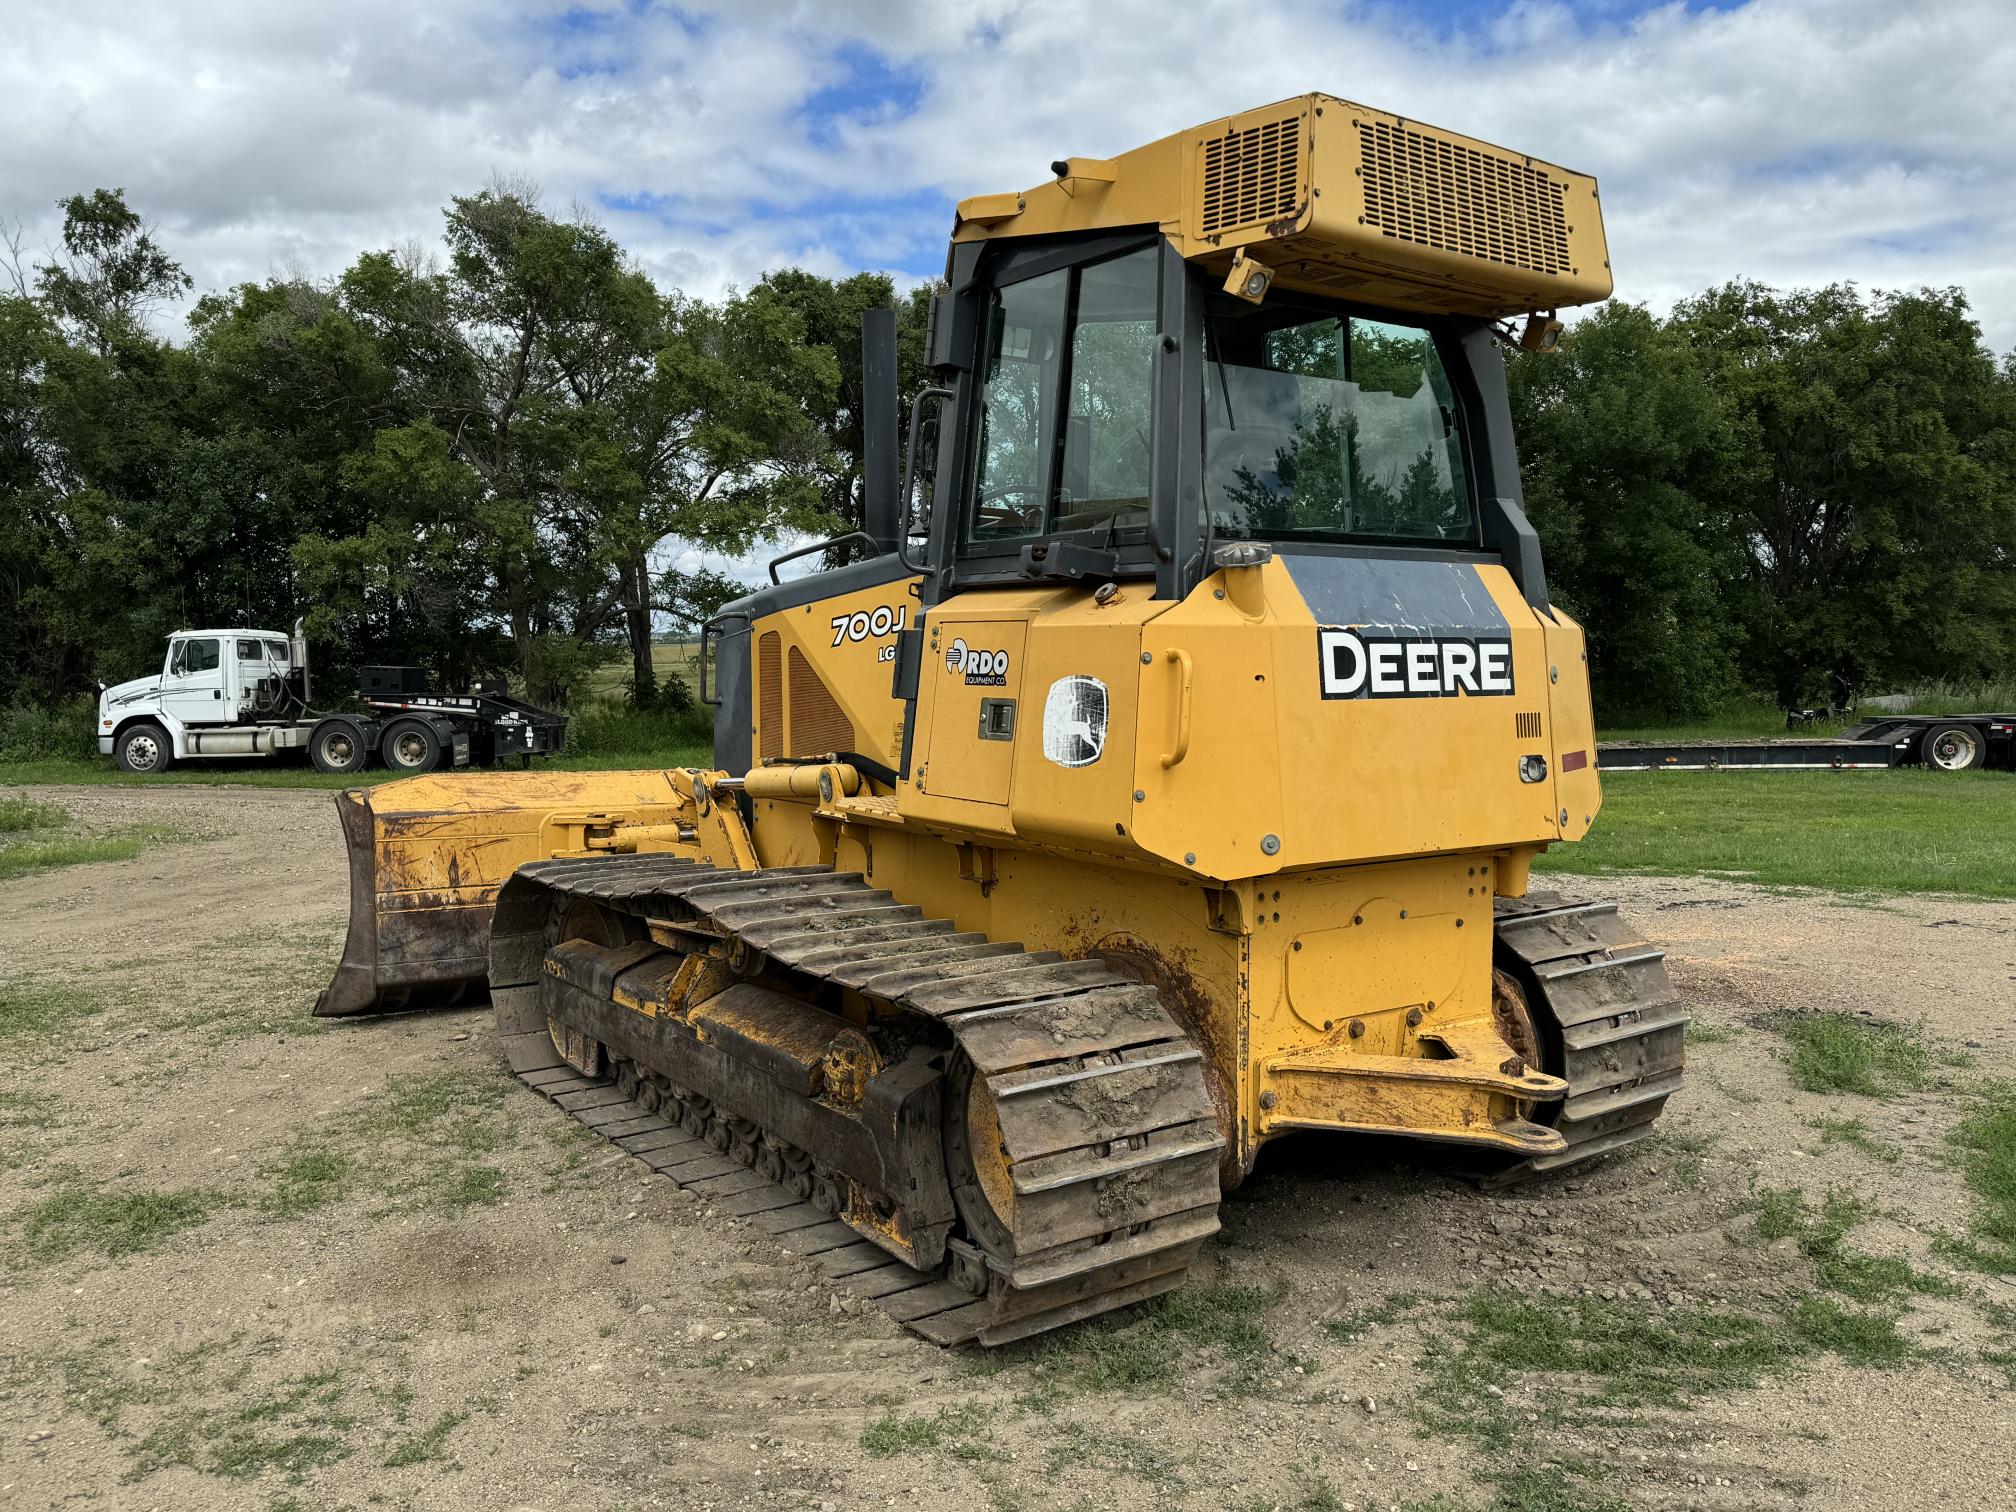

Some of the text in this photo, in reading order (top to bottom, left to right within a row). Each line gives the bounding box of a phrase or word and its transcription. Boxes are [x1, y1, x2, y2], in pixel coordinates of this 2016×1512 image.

[831, 605, 906, 648] 700J
[966, 676, 995, 685] EQUIPMENT
[1319, 630, 1513, 695] DEERE
